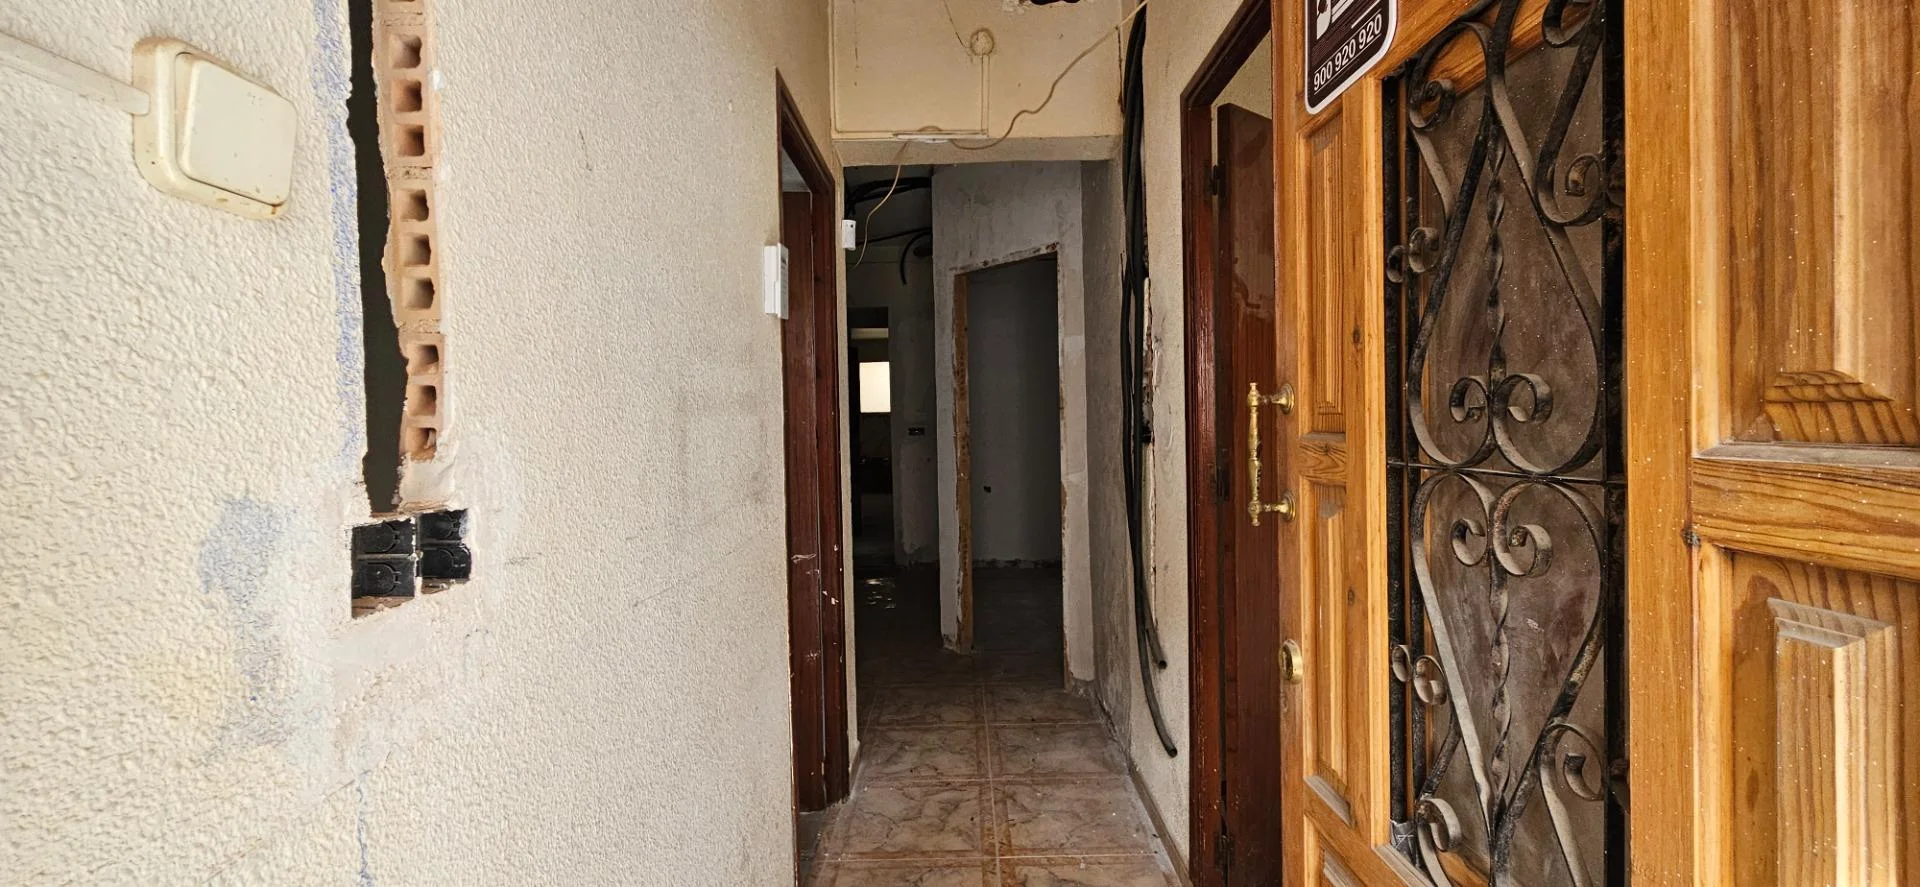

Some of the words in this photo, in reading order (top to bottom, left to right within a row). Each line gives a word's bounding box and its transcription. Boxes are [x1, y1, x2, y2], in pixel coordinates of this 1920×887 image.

[1313, 60, 1332, 91] 900
[1335, 38, 1356, 72] 920
[1358, 13, 1383, 50] 920
